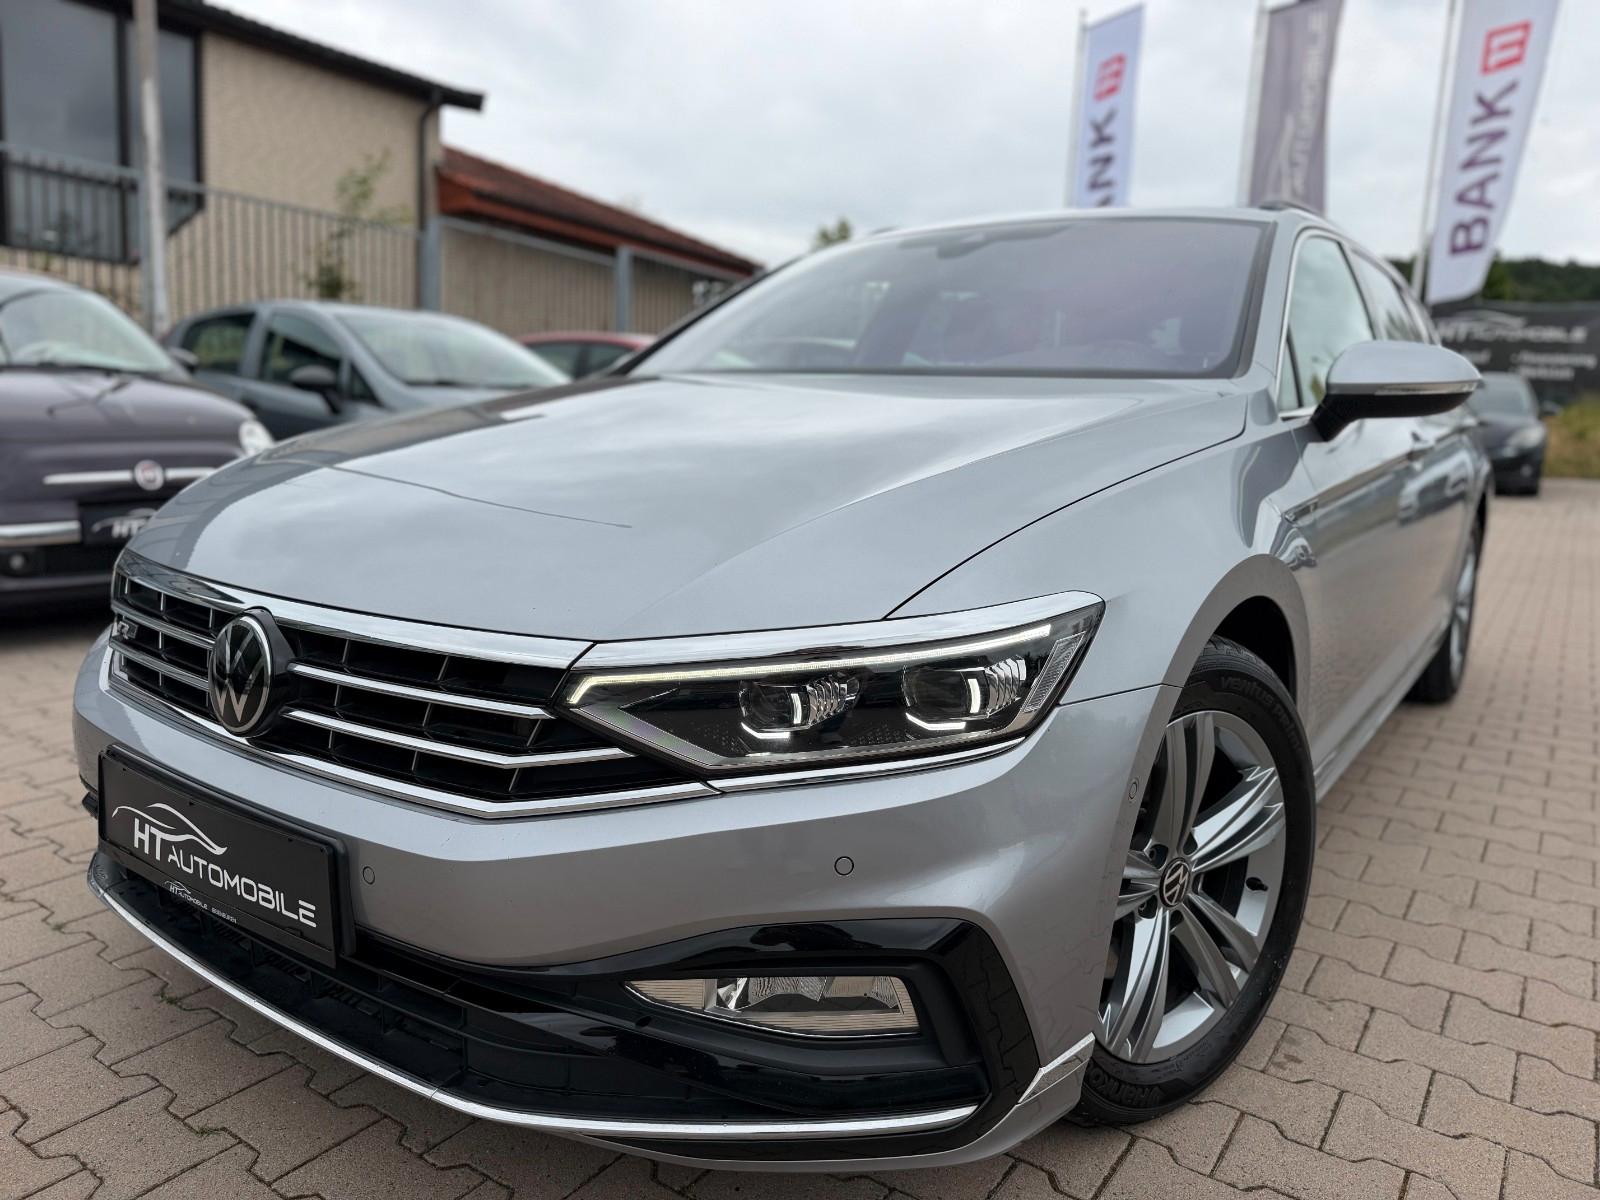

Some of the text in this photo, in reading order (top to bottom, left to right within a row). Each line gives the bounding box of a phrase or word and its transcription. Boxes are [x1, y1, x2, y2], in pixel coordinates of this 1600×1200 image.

[1087, 107, 1119, 210] NK
[1450, 79, 1521, 256] BANK
[134, 818, 317, 928] HT AUTOMOBILE
